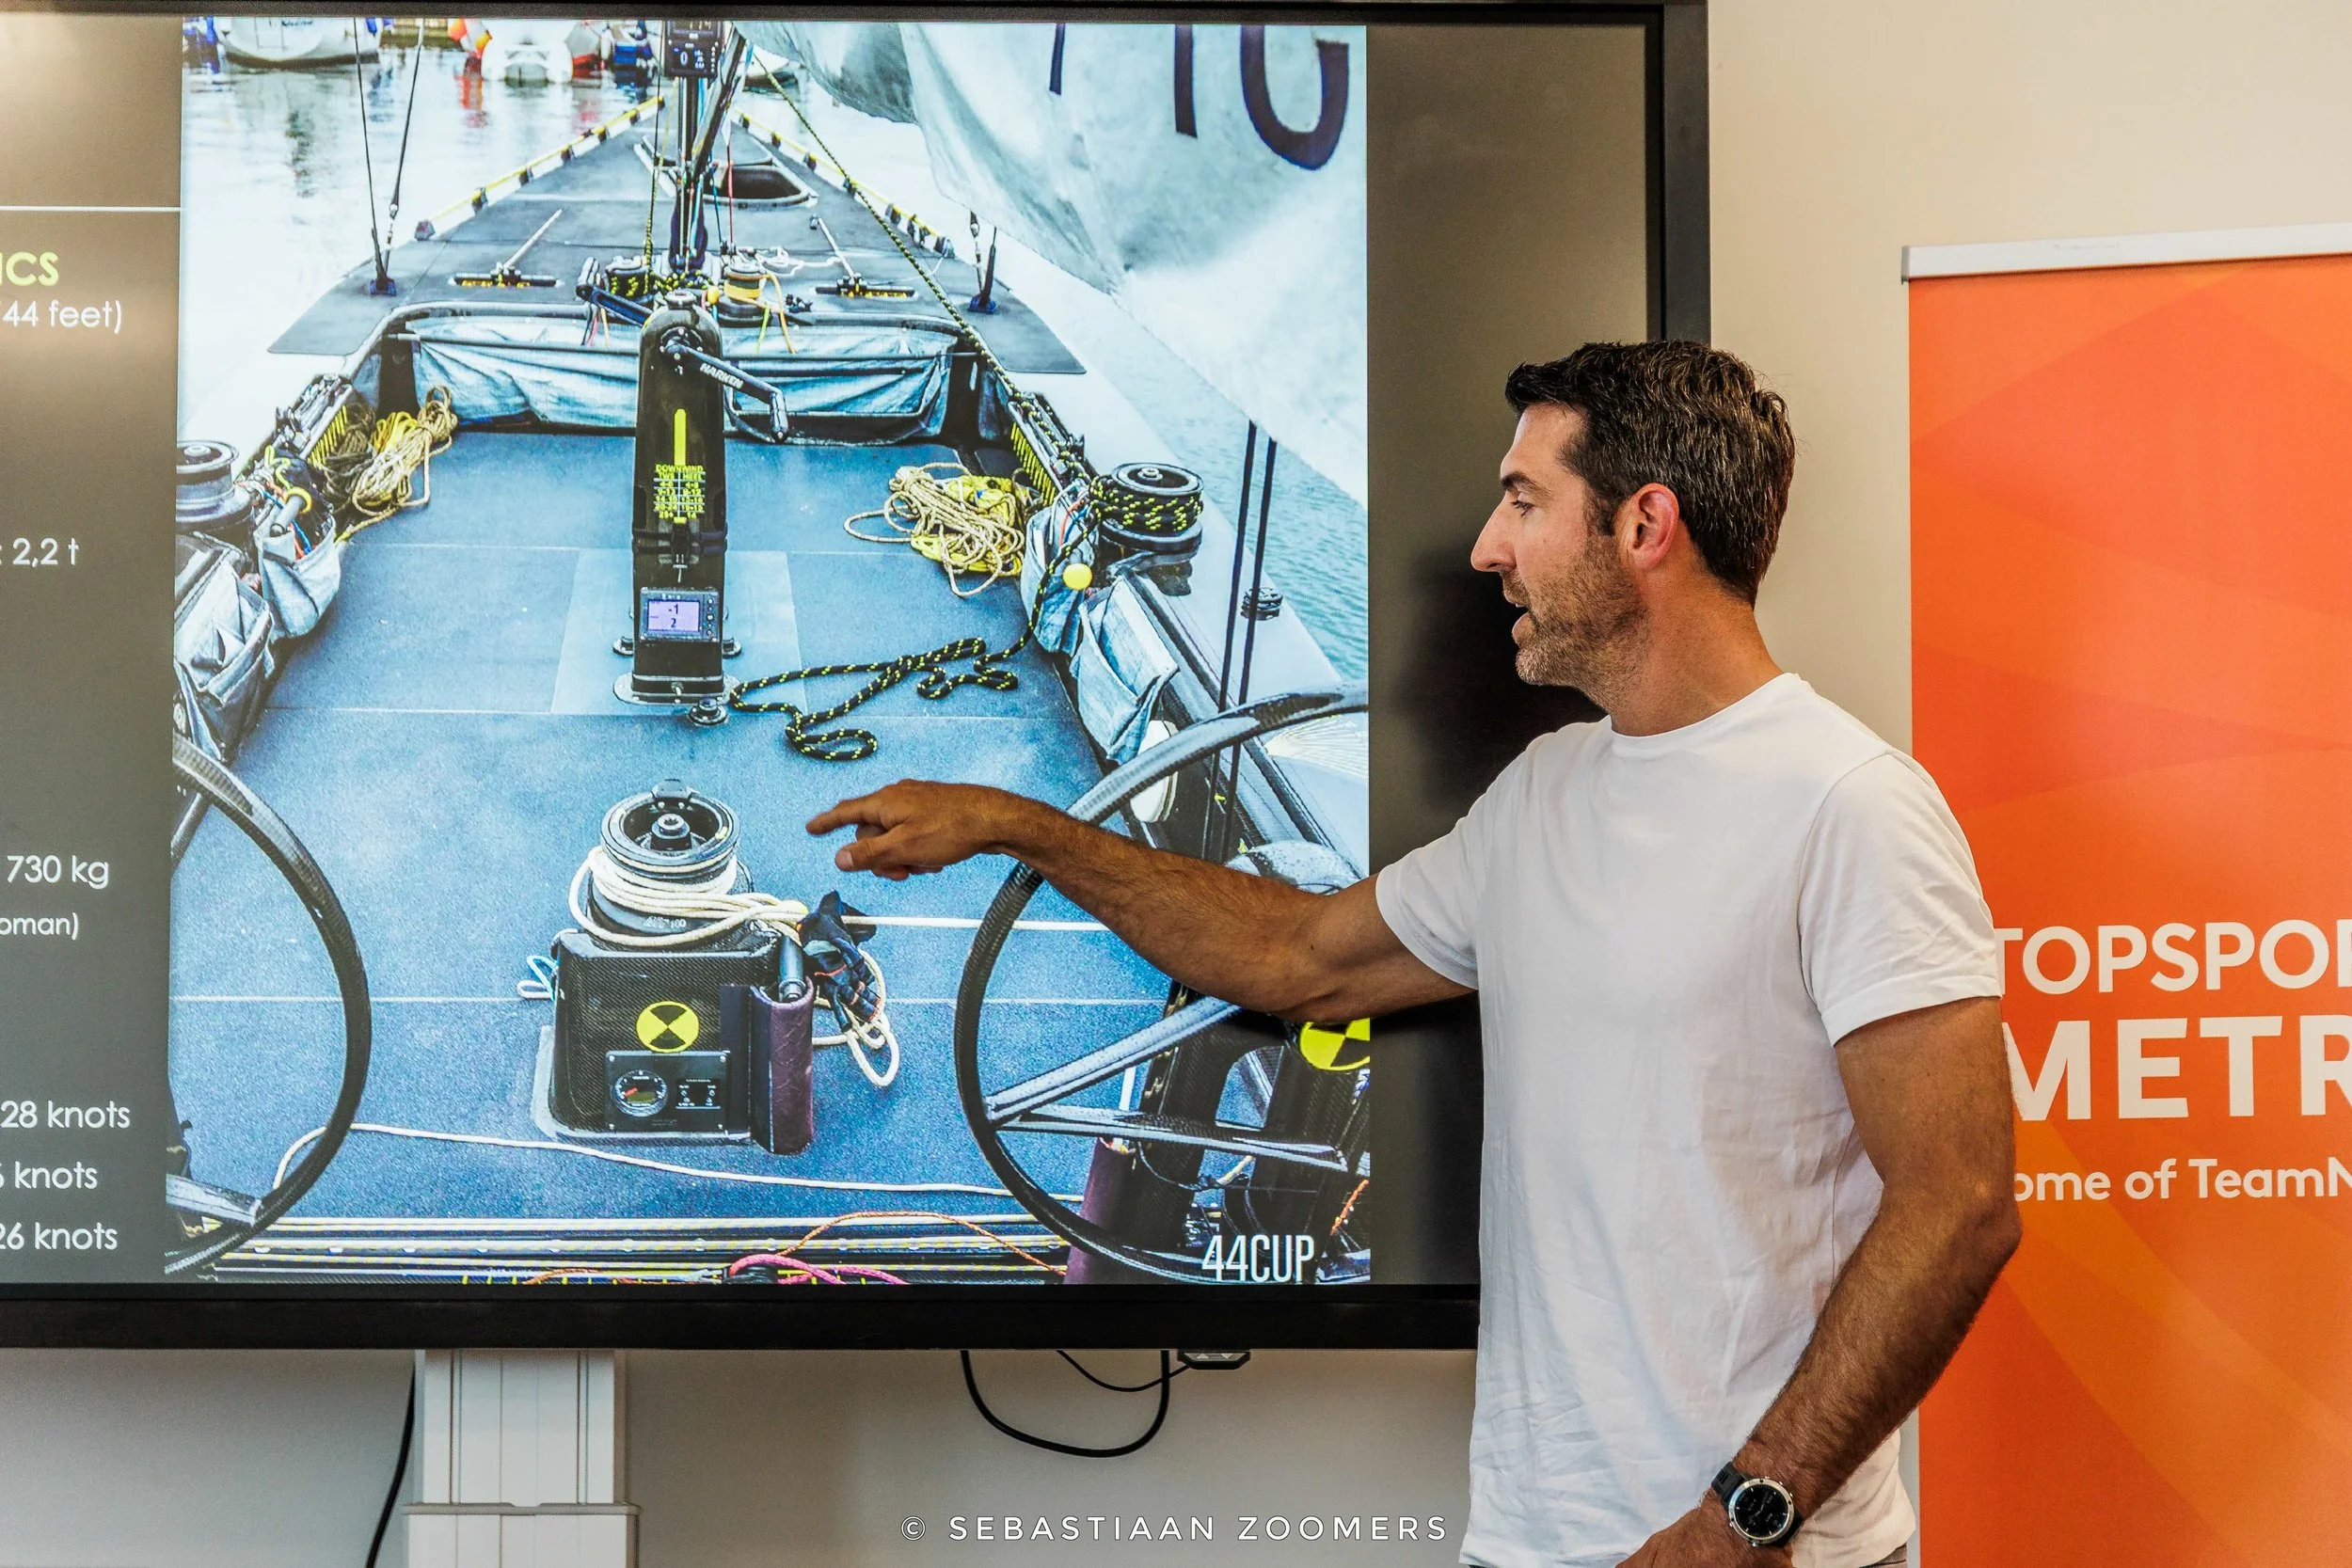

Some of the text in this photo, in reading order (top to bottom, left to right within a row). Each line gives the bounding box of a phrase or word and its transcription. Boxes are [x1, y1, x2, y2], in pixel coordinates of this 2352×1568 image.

[0, 299, 122, 335] 44 feet)
[699, 362, 744, 389] HARKEN
[12, 537, 80, 568] 2,2 t
[671, 618, 676, 627] 2
[7, 854, 110, 890] 730 kg
[0, 911, 80, 941] oman)
[2002, 1014, 2352, 1121] METR
[0, 1100, 131, 1129] 28 knots
[14, 1161, 99, 1190] knots
[2123, 1158, 2177, 1200] of
[2188, 1156, 2352, 1199] TeamN
[34, 1221, 119, 1251] knots
[1201, 1234, 1315, 1283] 44CUP
